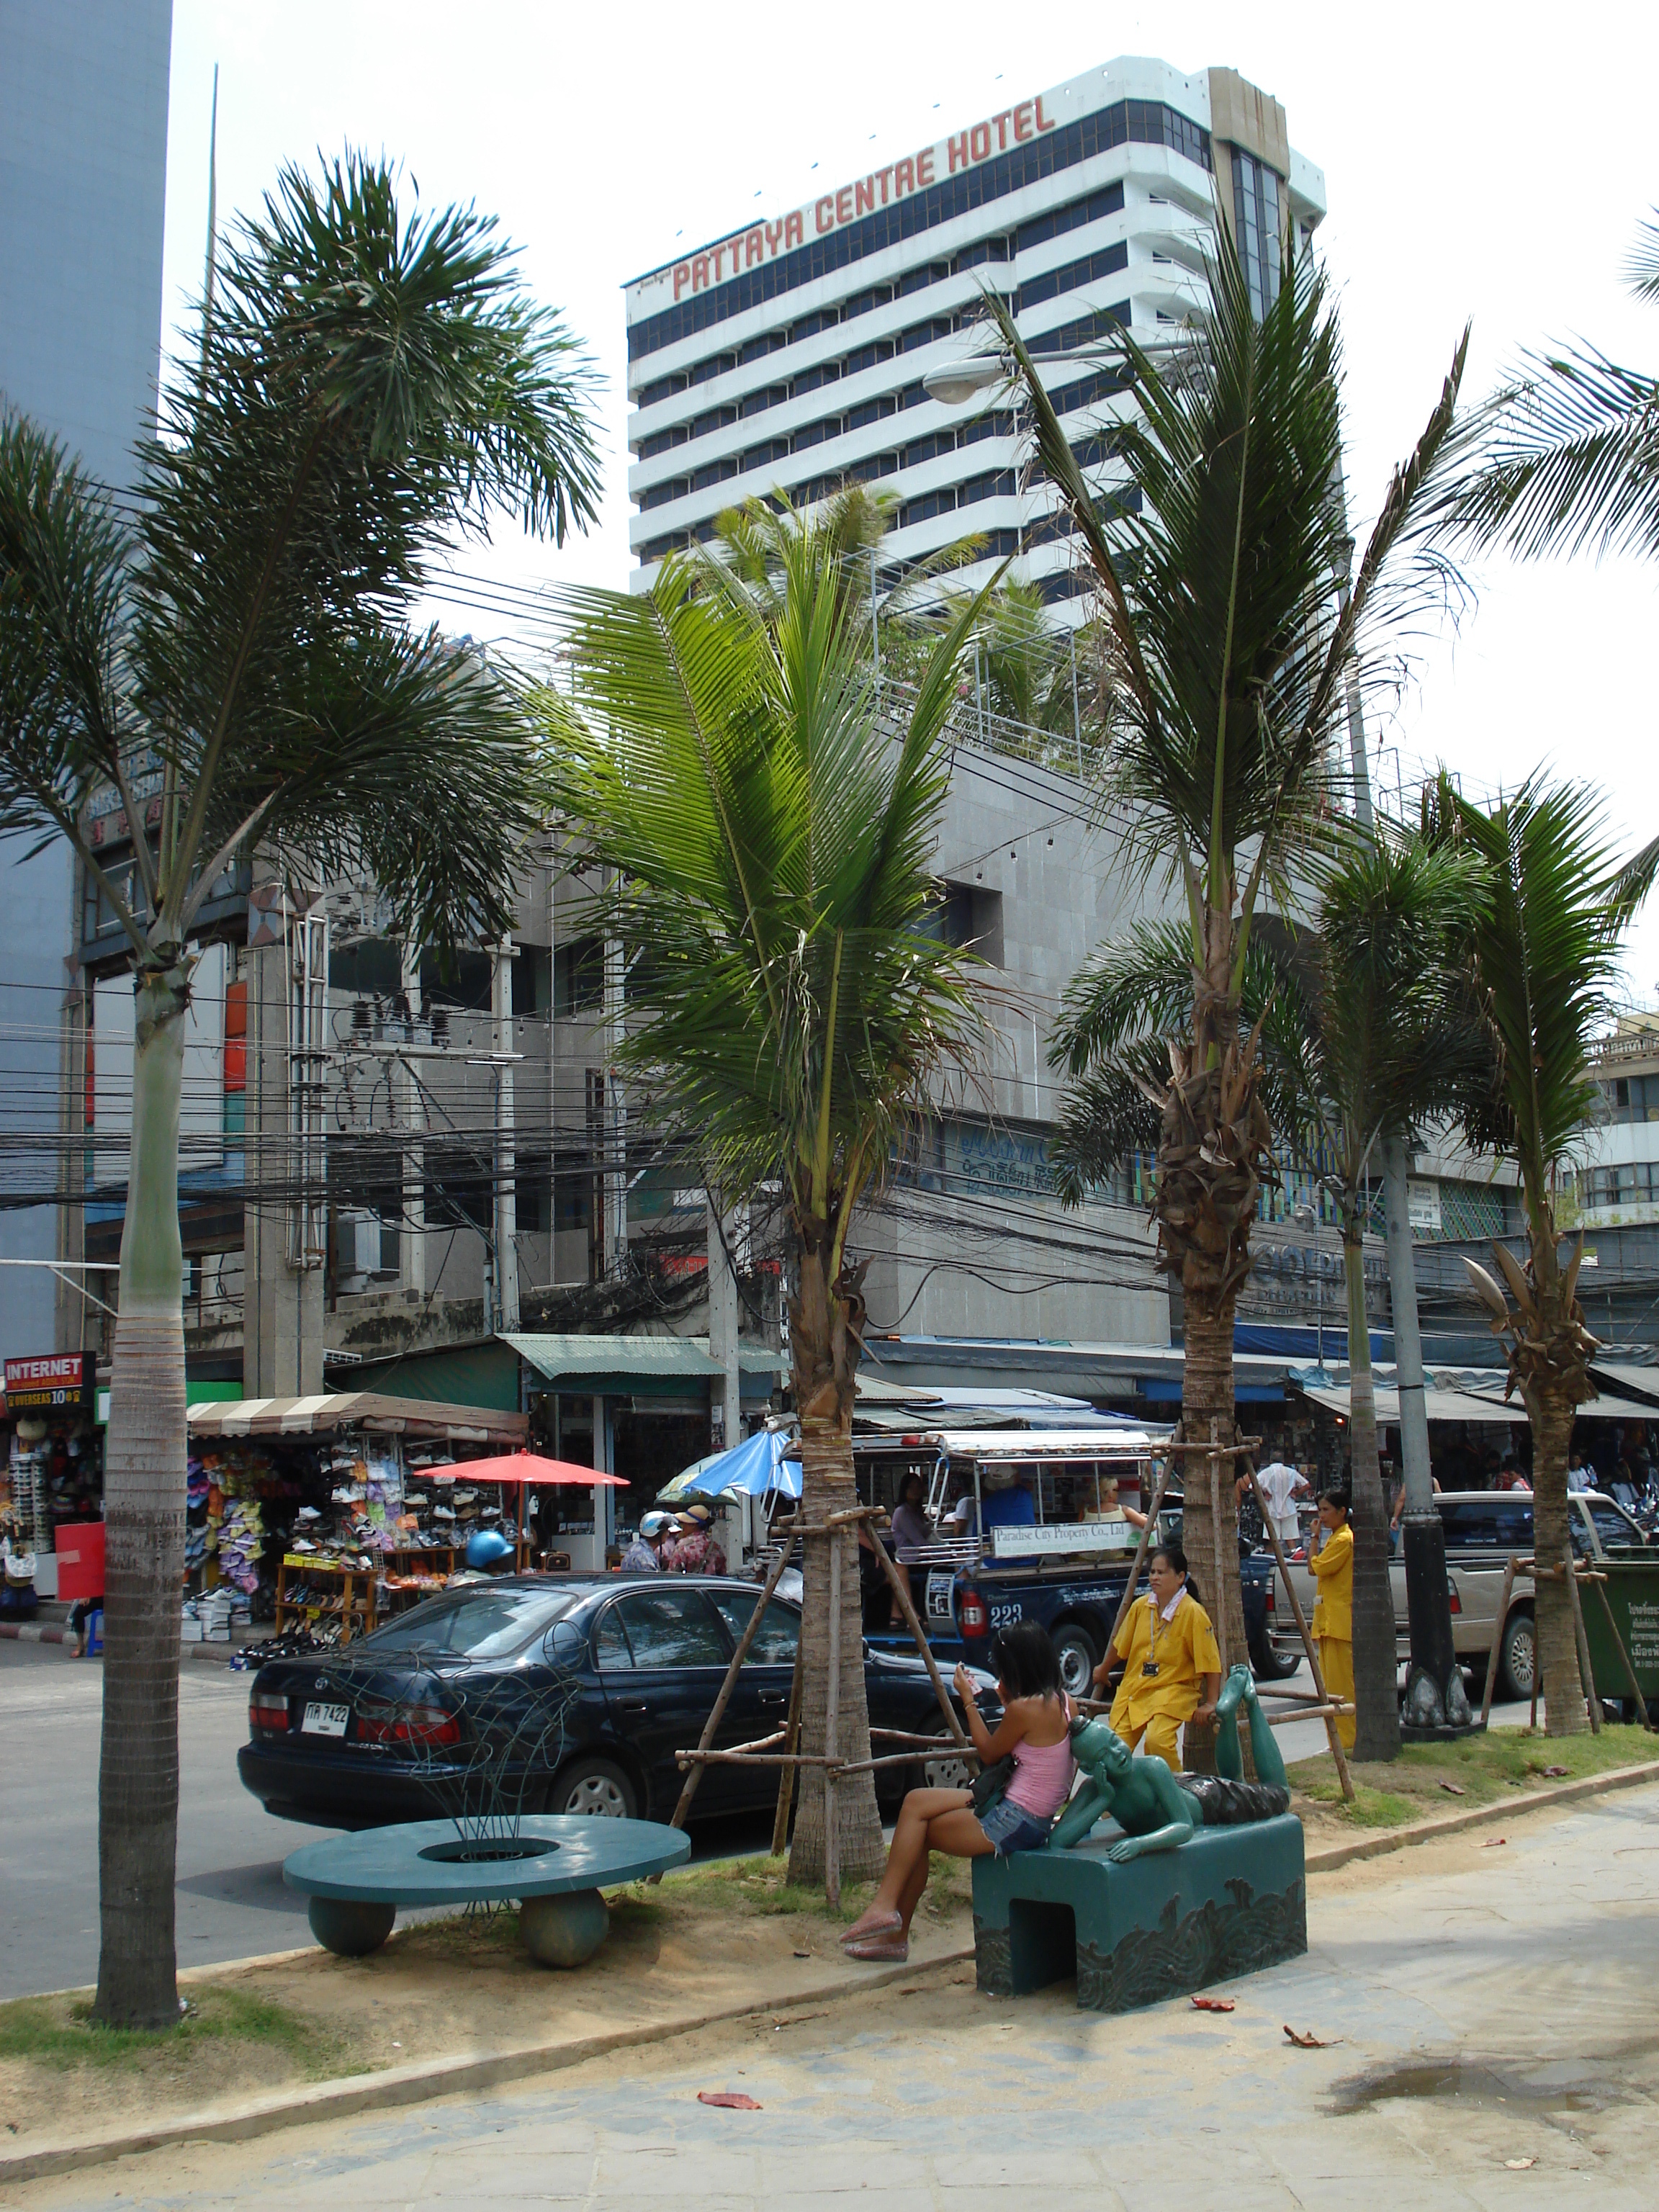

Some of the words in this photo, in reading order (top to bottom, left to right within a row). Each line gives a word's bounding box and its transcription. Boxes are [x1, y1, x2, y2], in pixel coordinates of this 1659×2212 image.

[673, 210, 804, 302] PATTAYA
[814, 146, 936, 234] CENTRE
[948, 96, 1056, 174] HOTEL
[6, 1357, 81, 1380] INTERNET
[14, 1392, 51, 1406] OVERSEAS
[51, 1389, 65, 1404] 10
[997, 1527, 1033, 1542] Paradise
[1035, 1526, 1052, 1542] City
[1054, 1524, 1089, 1541] Property
[1110, 1522, 1125, 1535] Ltd
[990, 1603, 1022, 1629] 223
[323, 1705, 347, 1722] 7422
